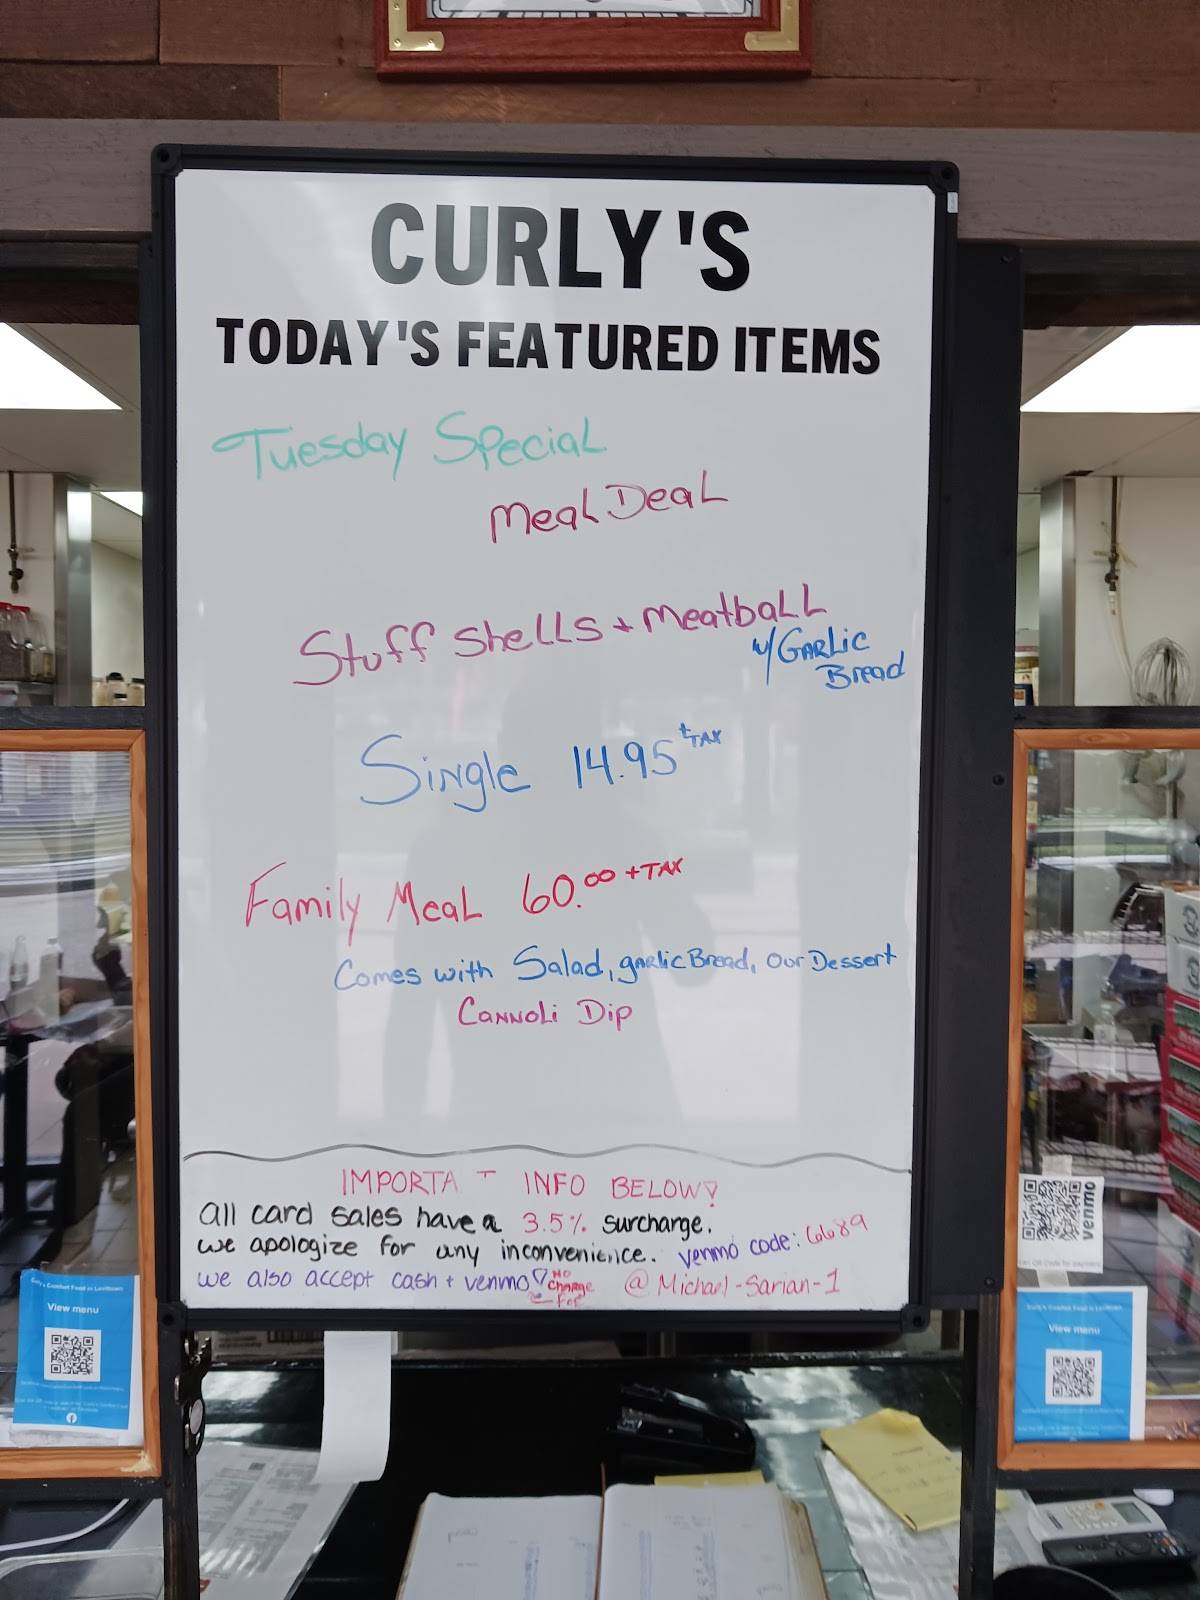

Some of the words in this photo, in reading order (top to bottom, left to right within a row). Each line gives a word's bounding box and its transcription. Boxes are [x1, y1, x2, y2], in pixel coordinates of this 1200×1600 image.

[371, 201, 752, 293] CURLY'S
[216, 317, 440, 367] TODAY'S
[457, 320, 719, 373] FEATURED
[734, 327, 881, 376] ITEMS
[211, 425, 408, 481] Tuesday
[292, 620, 437, 687] Stuff
[359, 734, 532, 813] Single
[572, 739, 678, 790] 14.95
[244, 861, 363, 946] Family
[333, 960, 423, 992] Comes
[433, 957, 494, 984] with
[808, 942, 898, 973] Dessert
[576, 998, 634, 1033] Dip
[523, 1170, 586, 1198] INFO
[250, 1201, 314, 1227] card
[330, 1205, 403, 1229] sales
[416, 1205, 476, 1234] have
[482, 1214, 503, 1234] a
[521, 1211, 588, 1235] 3.5%
[602, 1213, 713, 1243] surcharge.
[1082, 1181, 1097, 1241] venmo
[197, 1236, 236, 1254] we
[250, 1233, 358, 1263] apologize
[380, 1233, 416, 1257] for
[436, 1241, 480, 1268] any
[749, 1231, 802, 1257] code:
[247, 1269, 293, 1290] also
[305, 1268, 375, 1290] accept
[391, 1270, 438, 1291] cash
[47, 1302, 71, 1313] View
[72, 1305, 99, 1315] menu
[1048, 1321, 1072, 1334] View
[1073, 1325, 1100, 1336] menu
